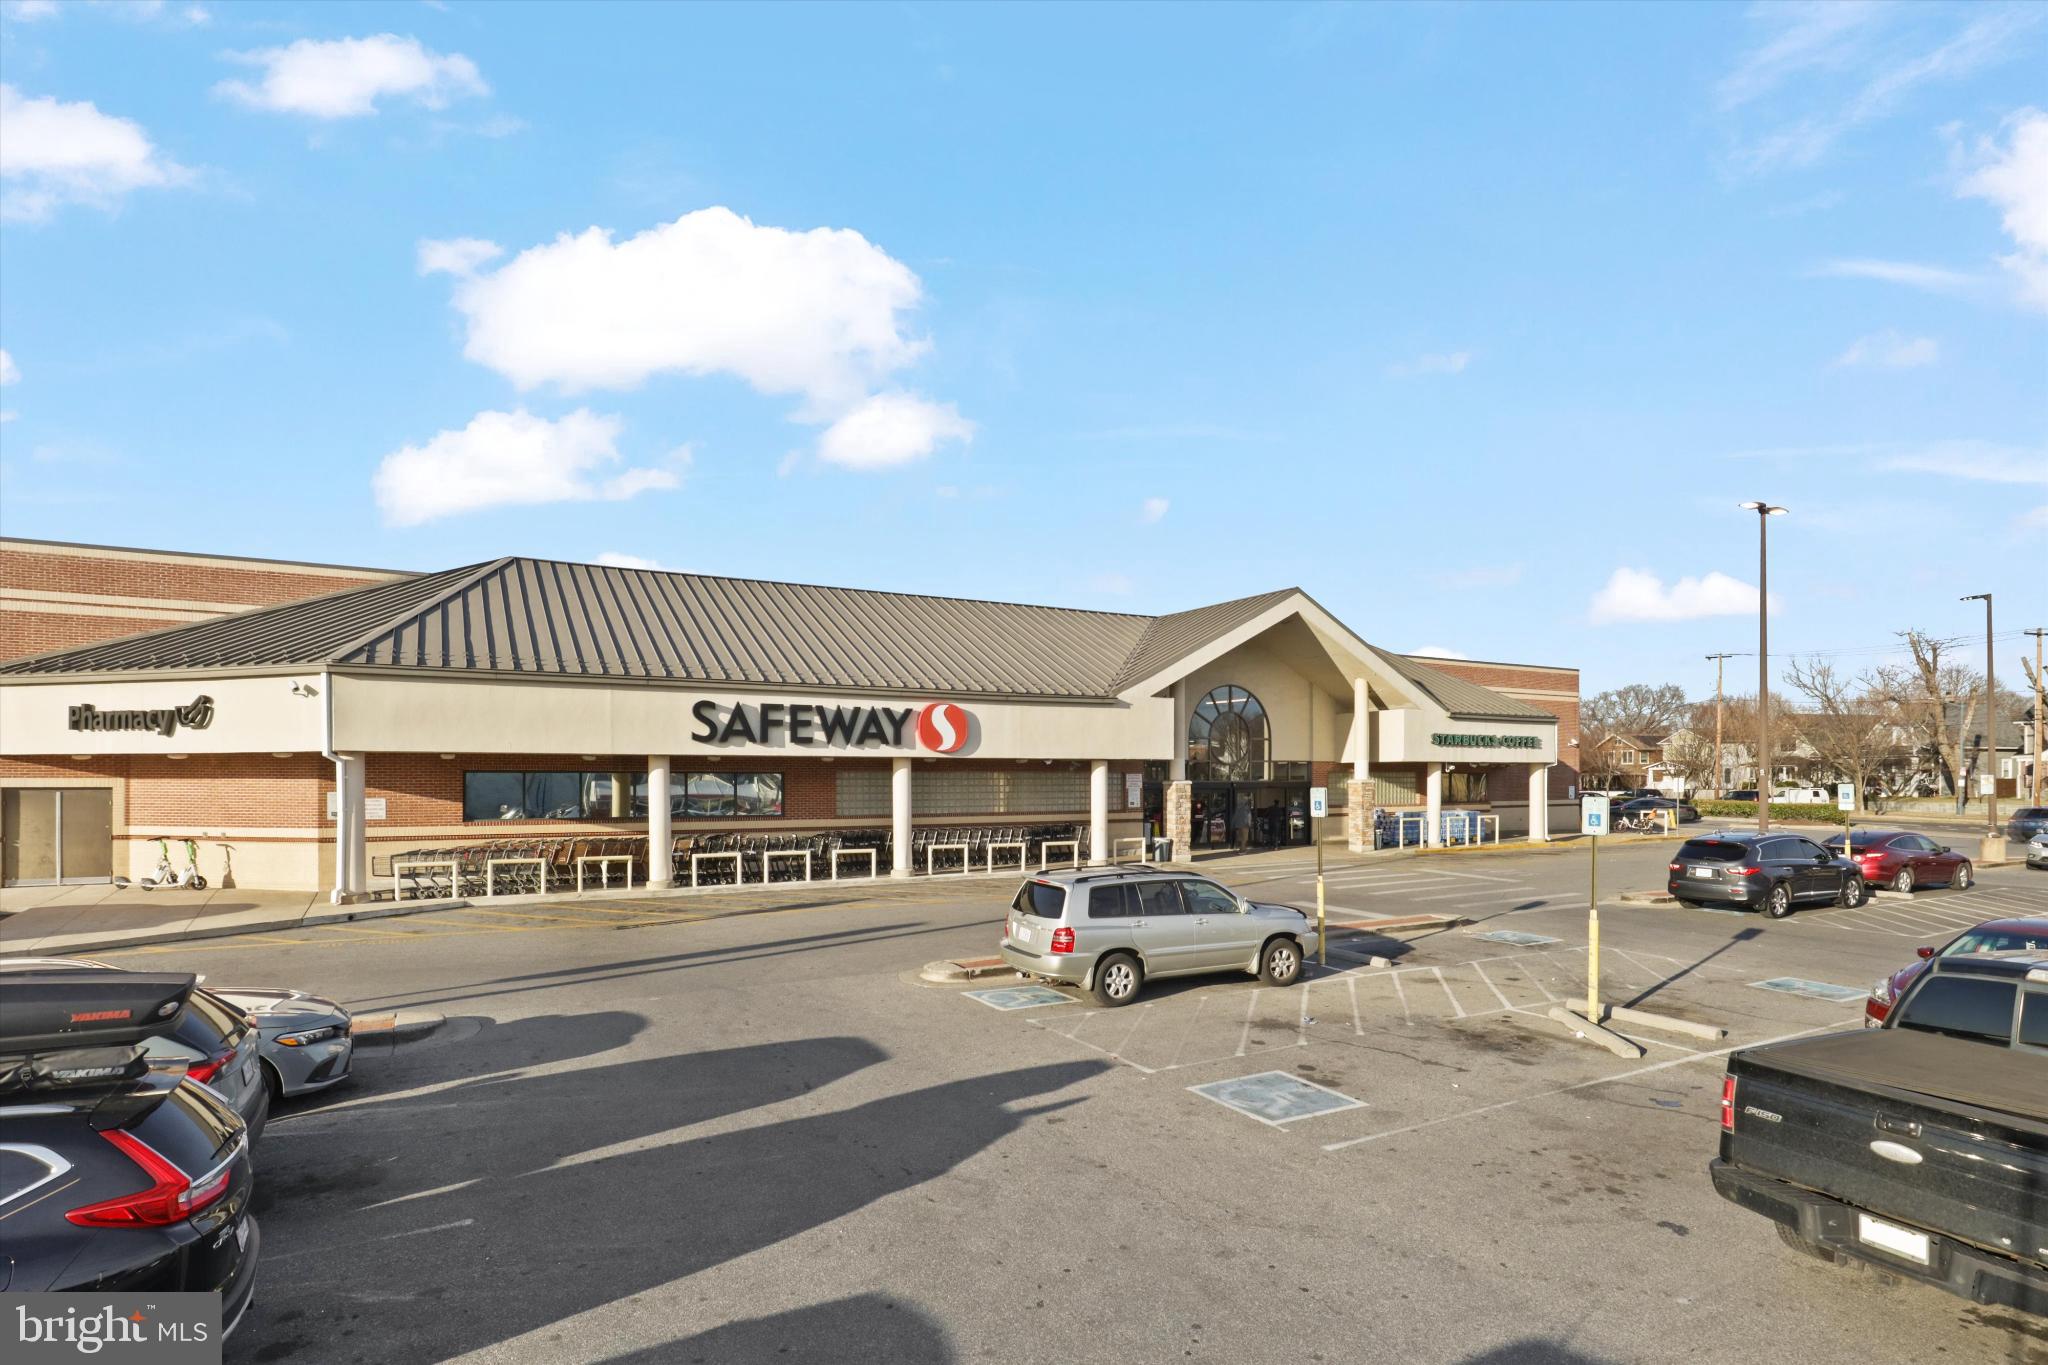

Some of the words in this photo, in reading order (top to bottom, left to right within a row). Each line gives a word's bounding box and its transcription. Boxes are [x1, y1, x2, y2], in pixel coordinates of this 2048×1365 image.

[68, 703, 176, 737] Pharmacy
[691, 700, 913, 746] SAFEWAY
[1431, 733, 1498, 748] STARBUCKS
[1501, 735, 1542, 749] COFFEE
[72, 1010, 131, 1022] YAKIMA
[52, 1066, 125, 1079] YAKIMA
